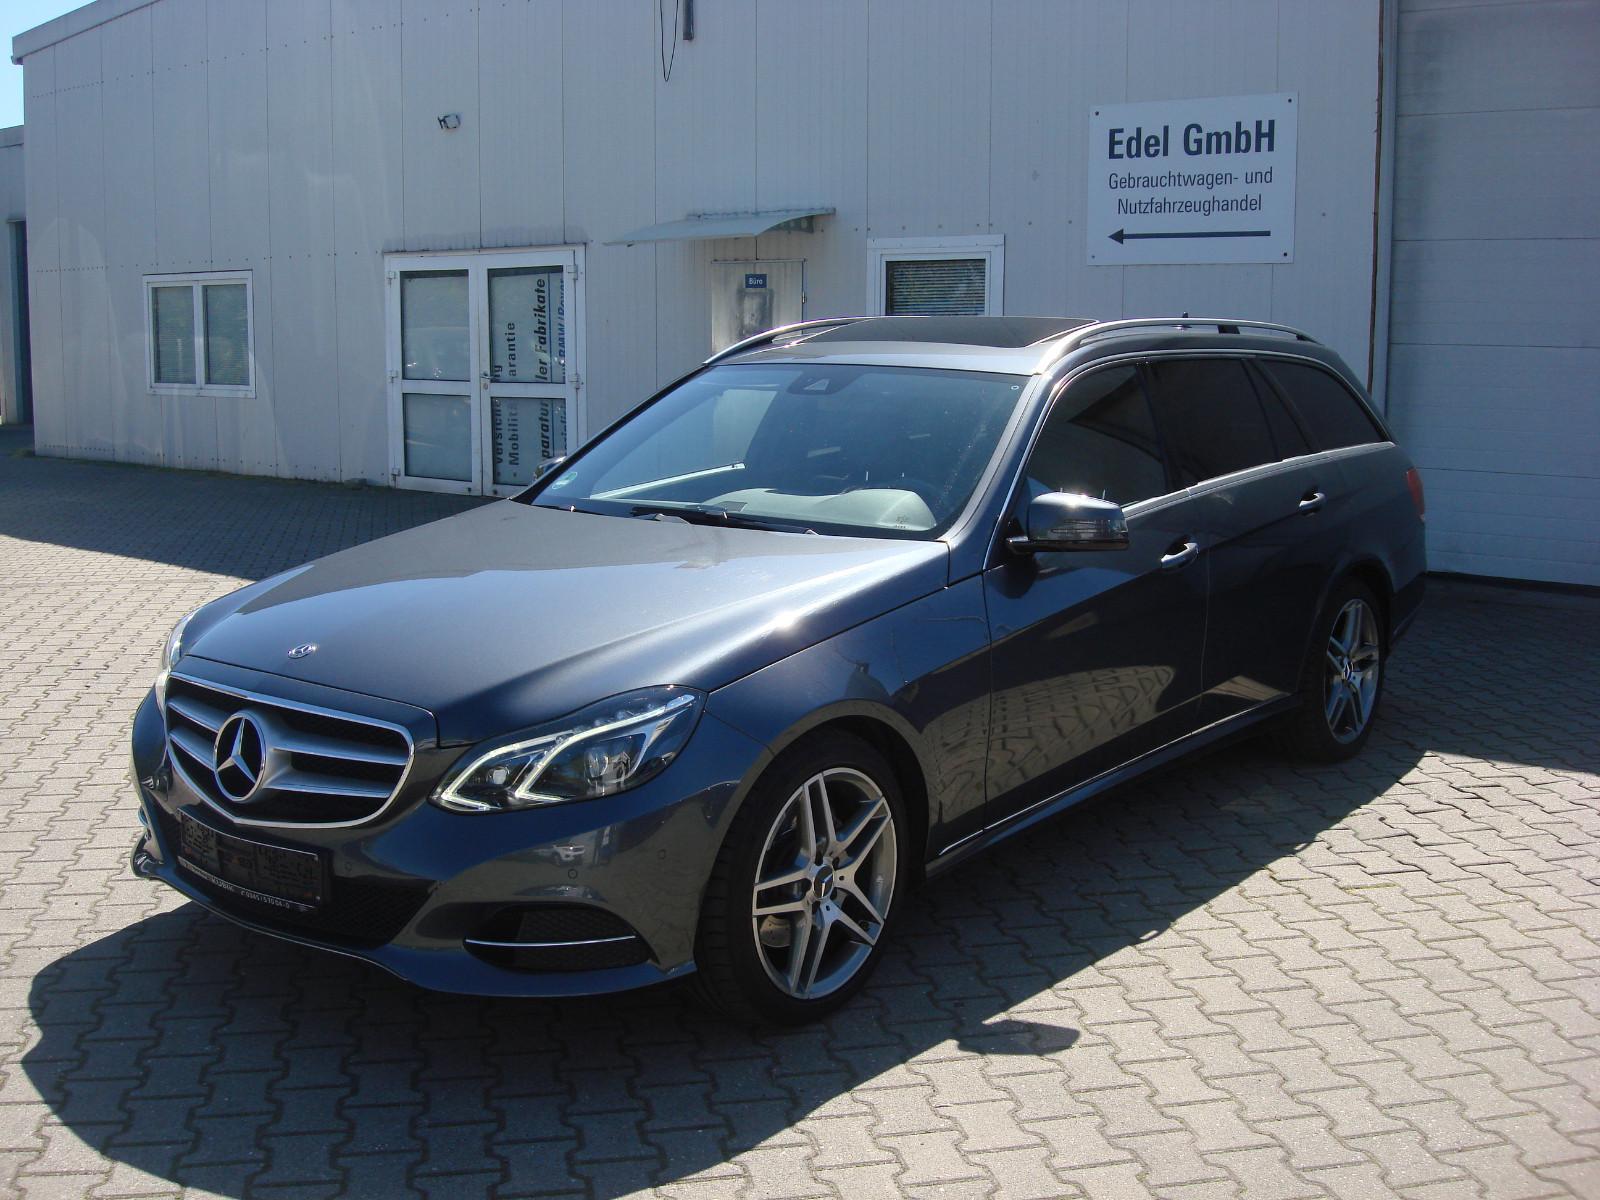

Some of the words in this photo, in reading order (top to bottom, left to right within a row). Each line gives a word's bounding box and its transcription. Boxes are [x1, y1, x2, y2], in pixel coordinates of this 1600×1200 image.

[1108, 125, 1169, 160] Edel
[1183, 119, 1275, 156] GmbH
[1108, 169, 1239, 190] Gebrauchtwagen-
[1244, 166, 1273, 185] und
[1117, 194, 1262, 217] Nutzfahrzeughandel
[748, 277, 763, 285] Büro
[532, 278, 547, 354] Fabrikate
